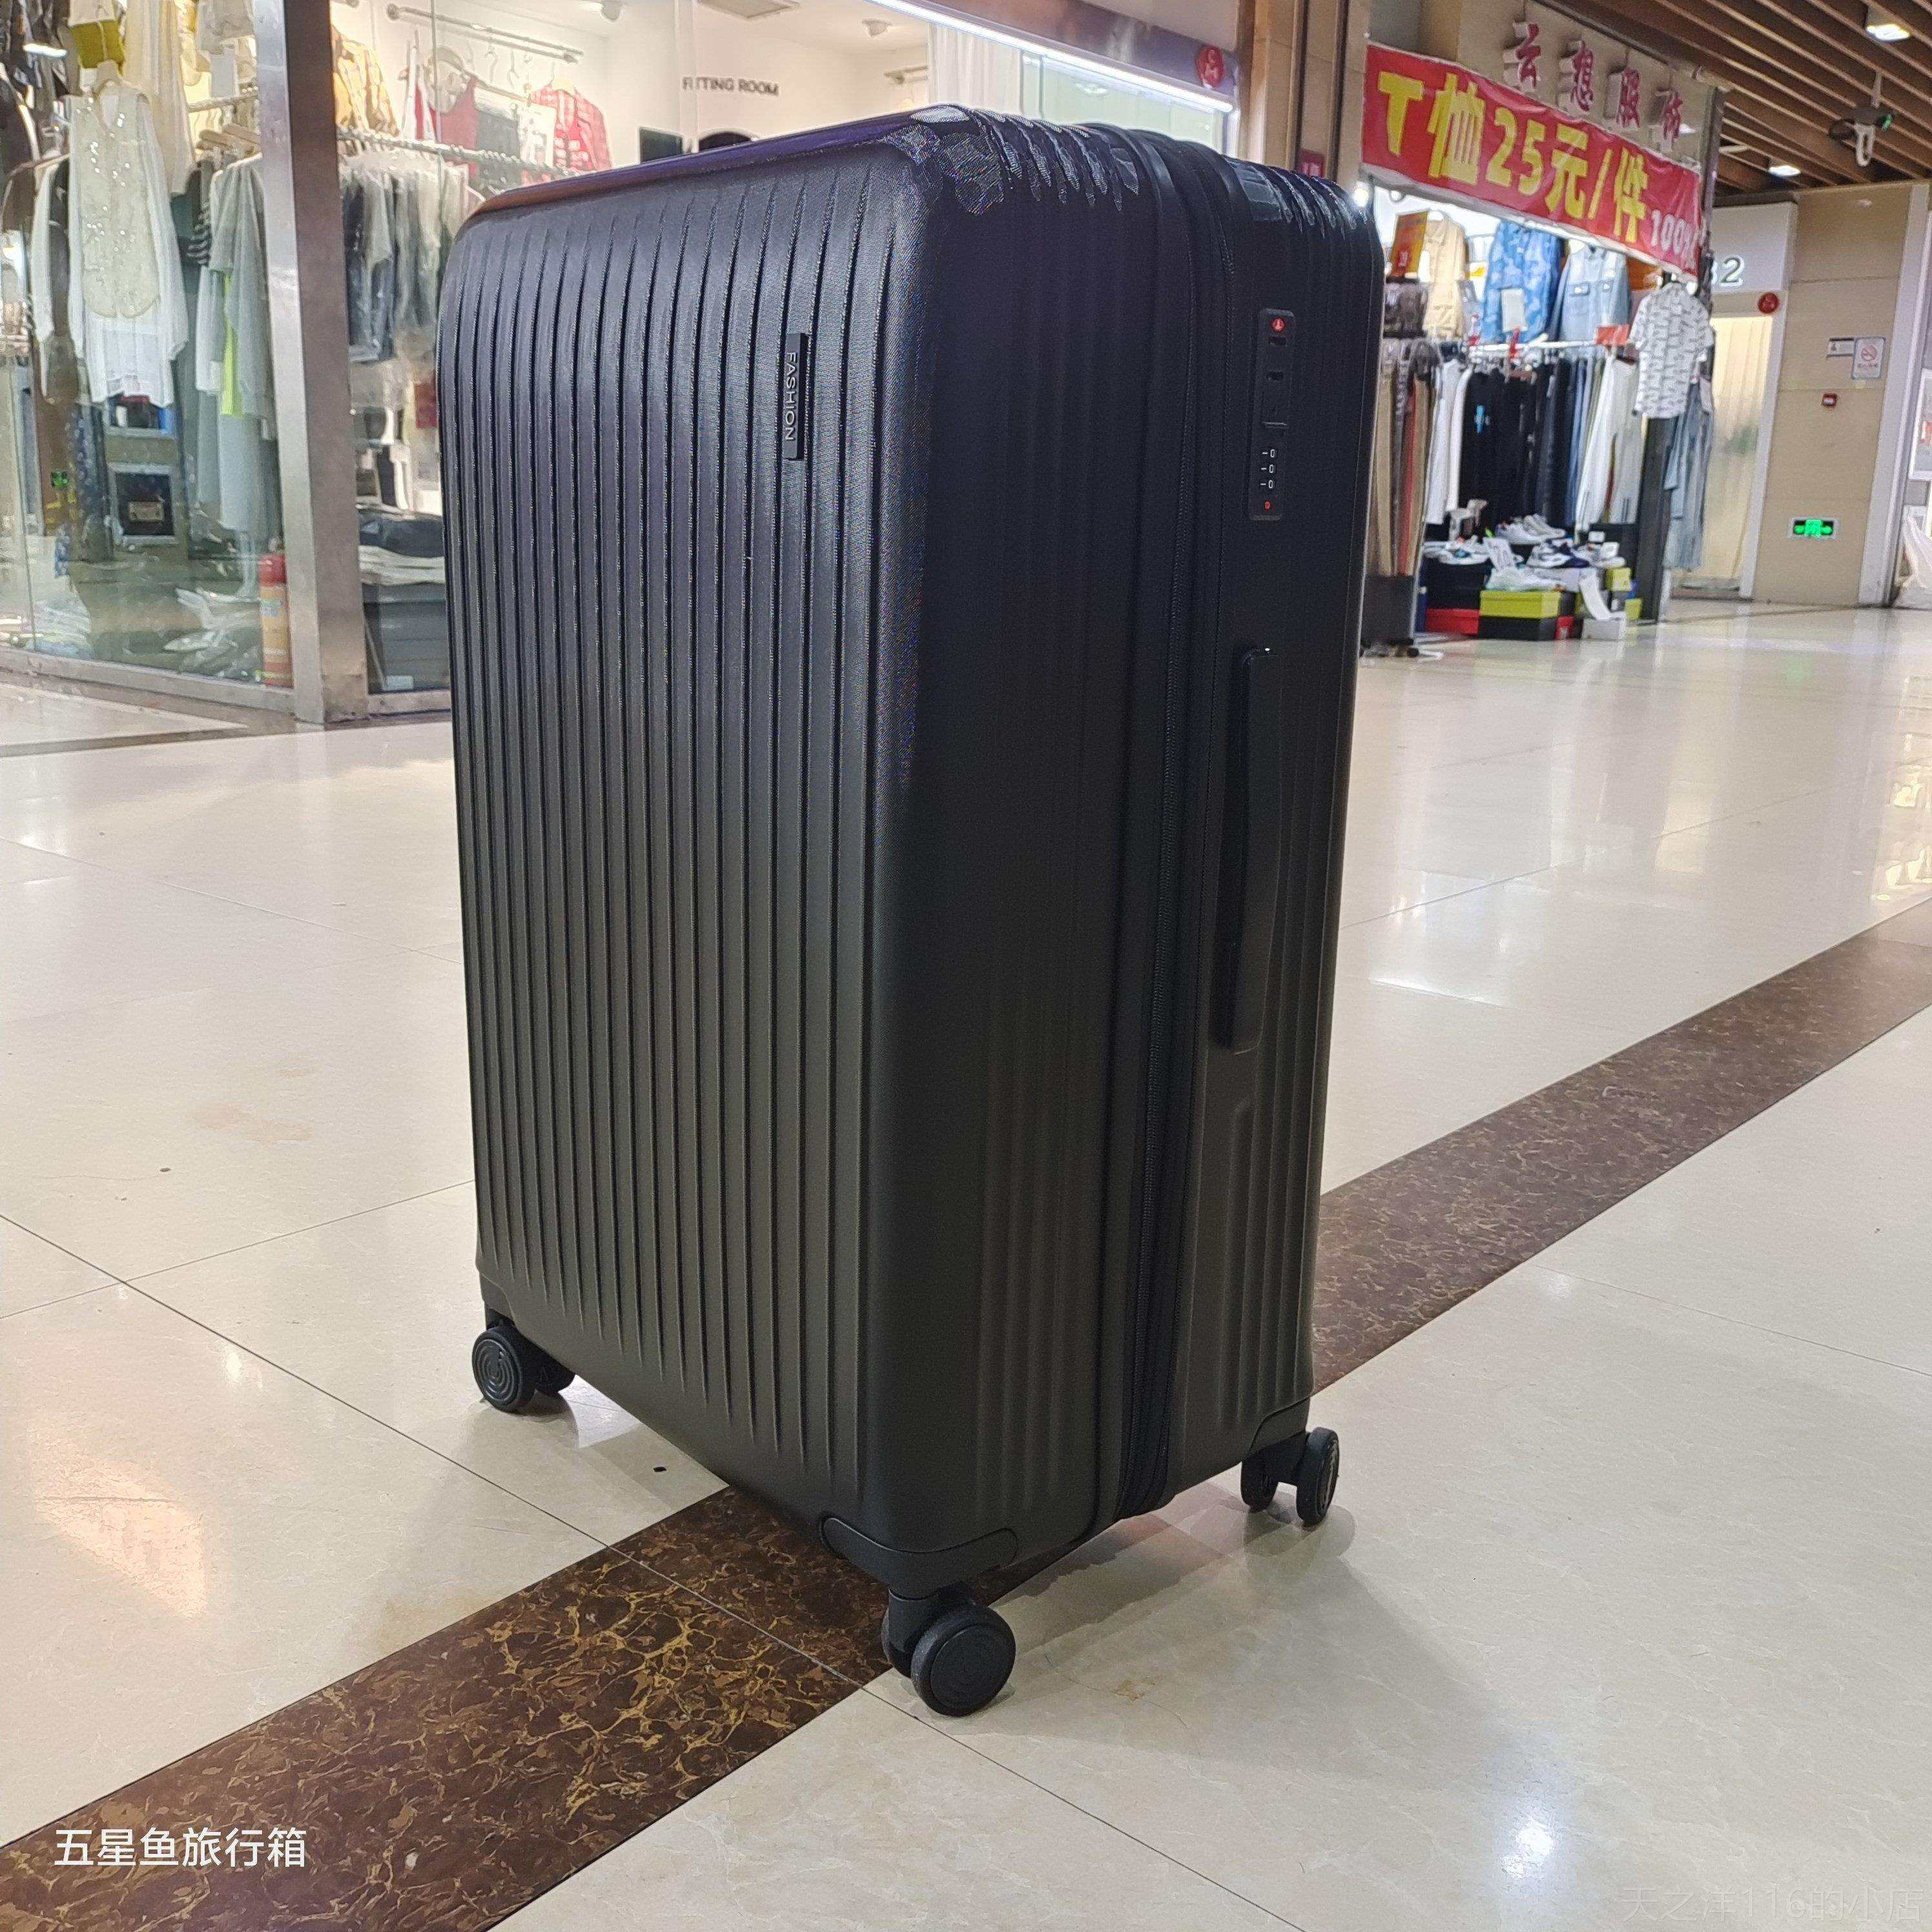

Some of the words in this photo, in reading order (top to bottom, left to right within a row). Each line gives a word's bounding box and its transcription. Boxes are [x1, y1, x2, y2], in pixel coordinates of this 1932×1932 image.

[682, 76, 735, 91] FITTING
[739, 78, 779, 96] ROOM
[785, 351, 798, 441] FASHION
